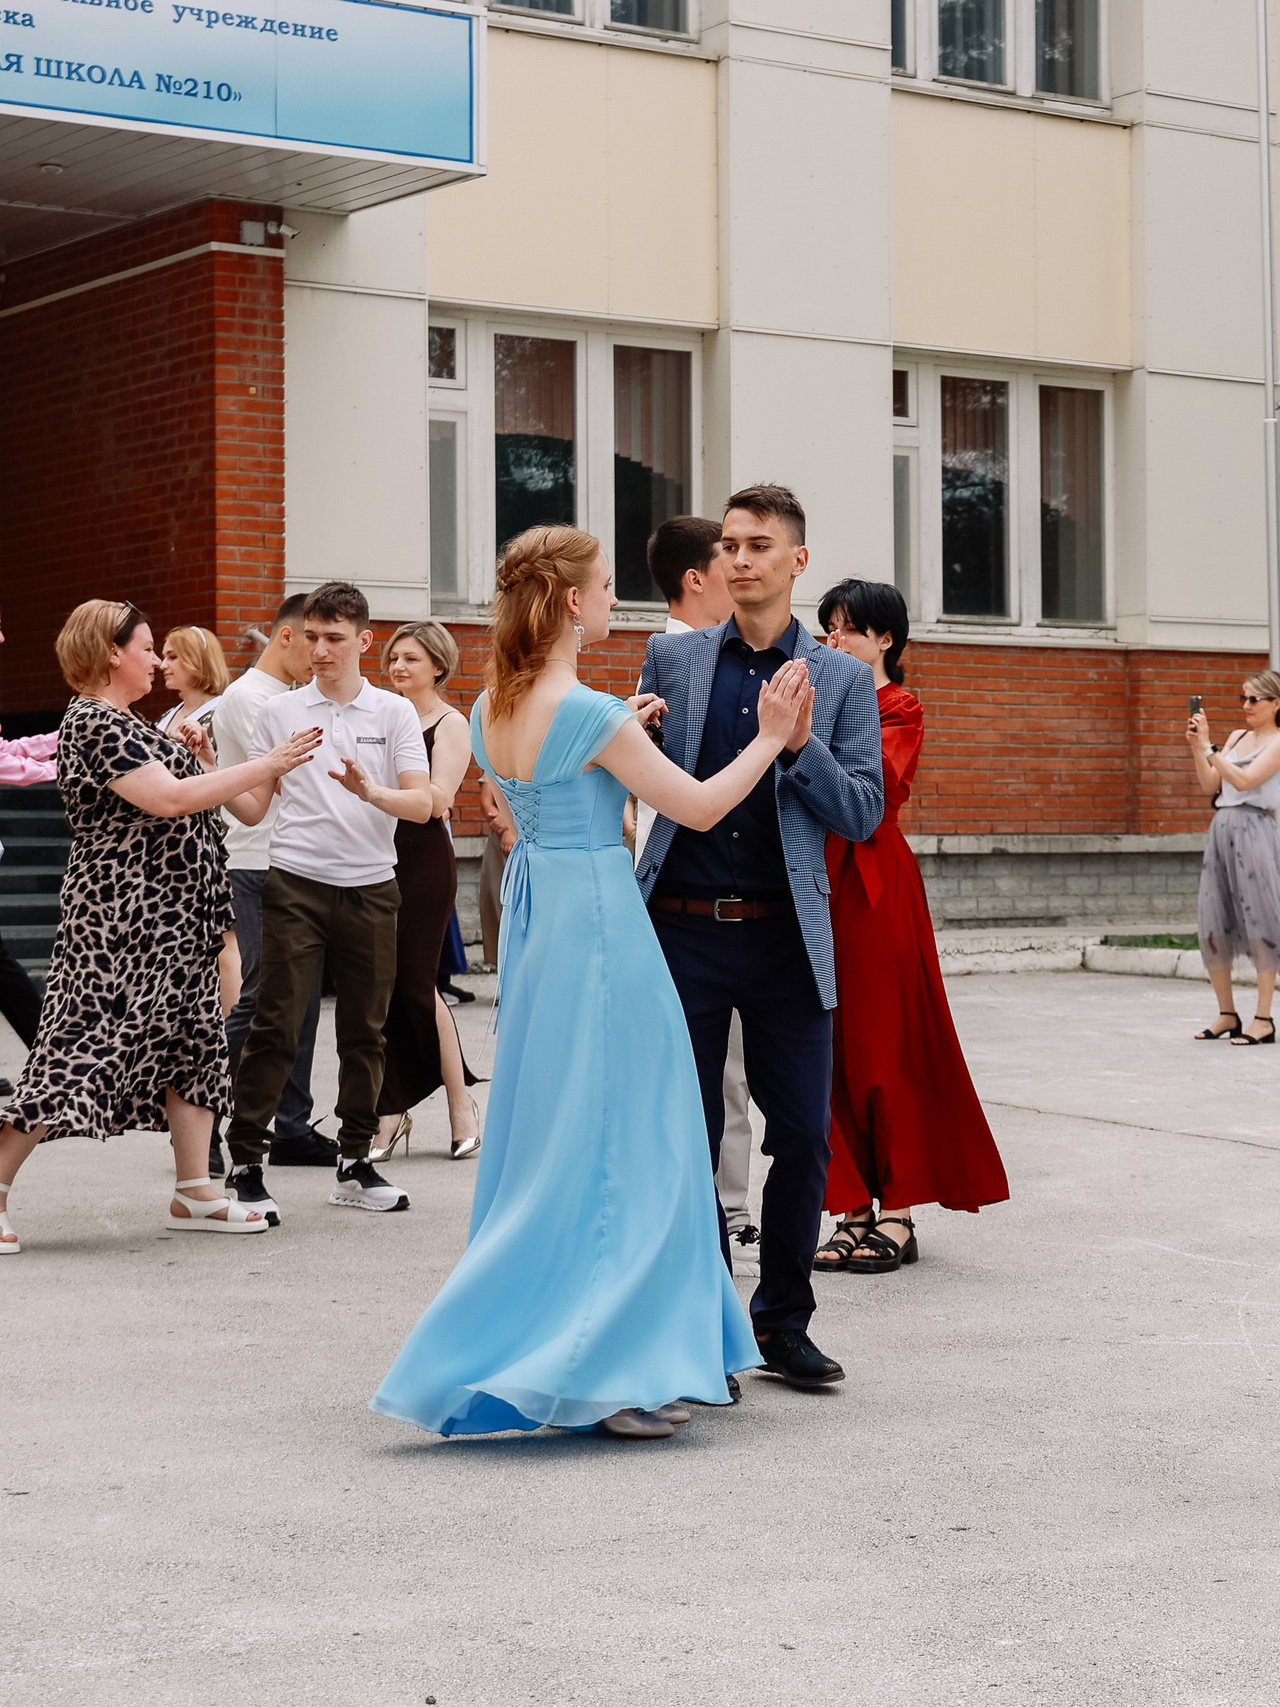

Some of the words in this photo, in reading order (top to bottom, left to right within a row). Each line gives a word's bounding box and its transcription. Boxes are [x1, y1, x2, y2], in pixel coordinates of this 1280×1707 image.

[0, 9, 36, 28] ка
[172, 4, 339, 42] учреждение
[0, 53, 24, 74] Я
[34, 56, 147, 90] ШКОЛА
[155, 73, 243, 102] №210»
